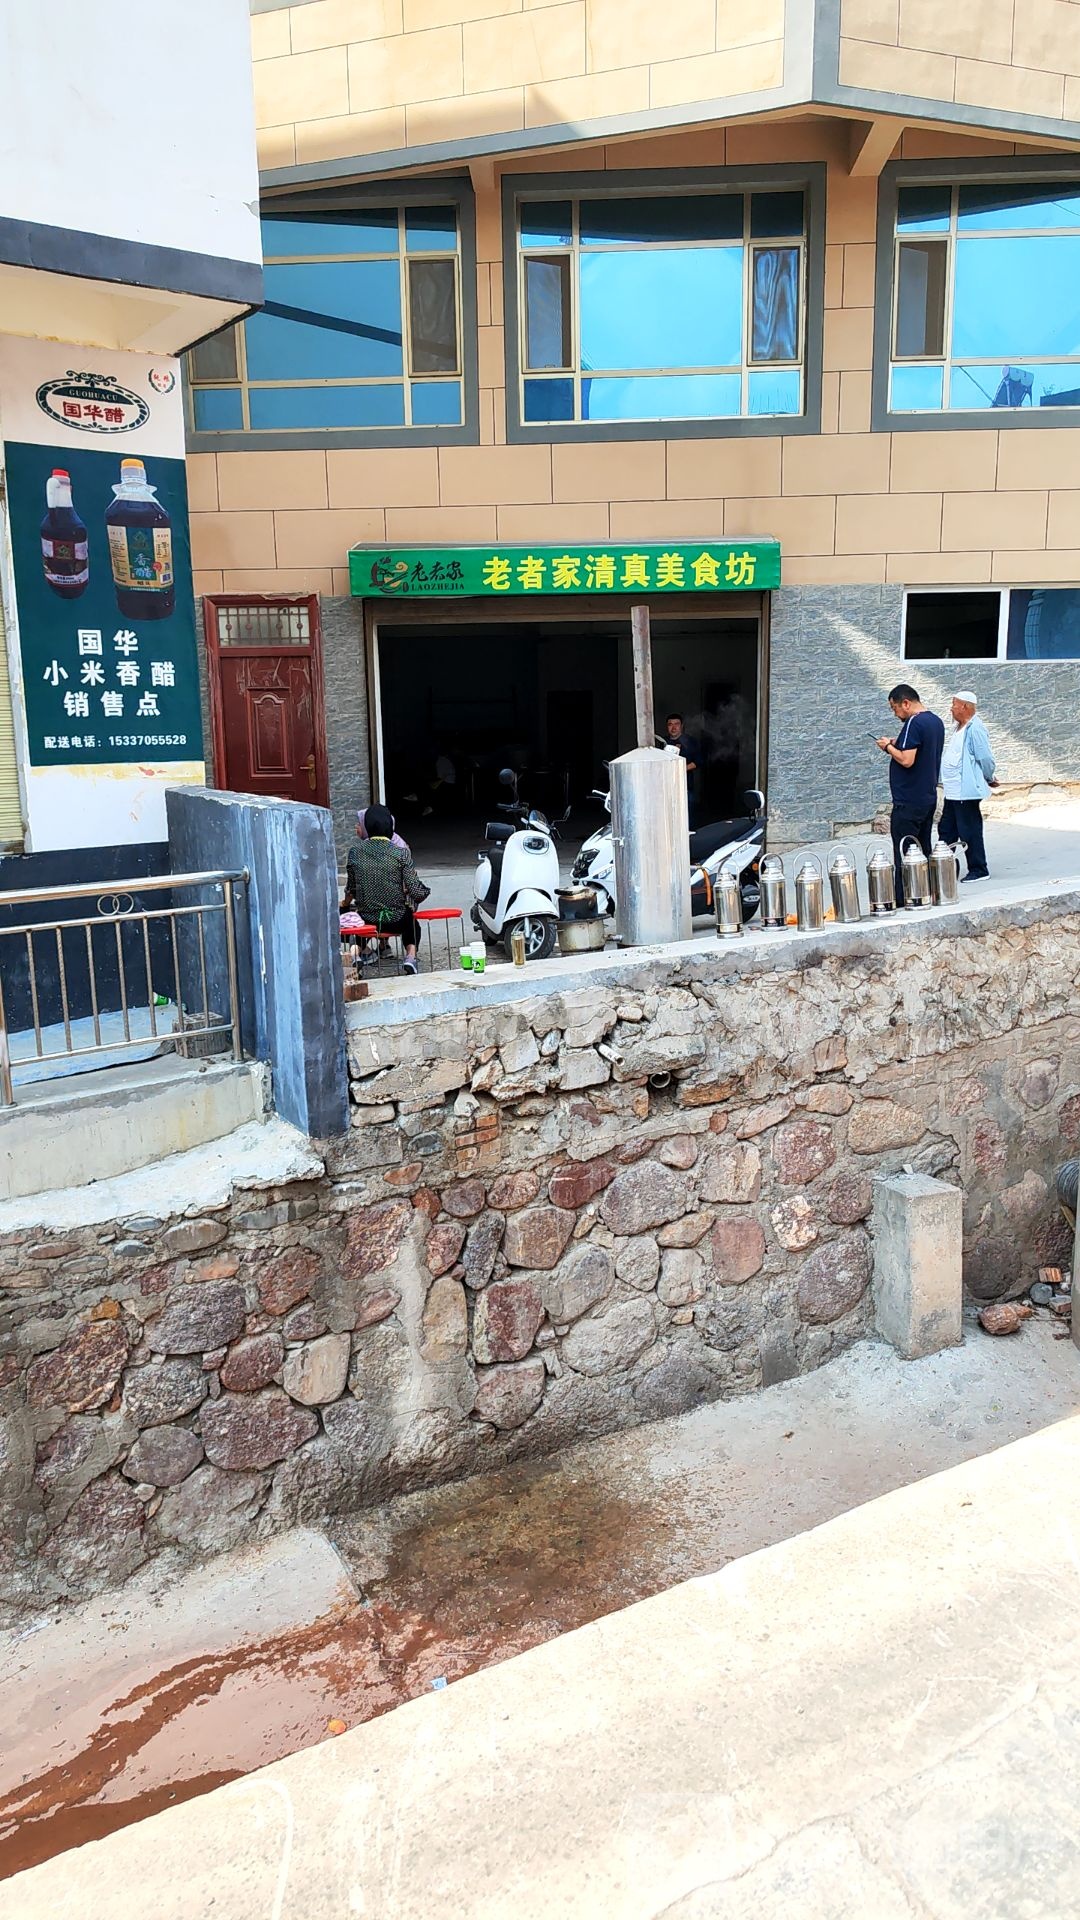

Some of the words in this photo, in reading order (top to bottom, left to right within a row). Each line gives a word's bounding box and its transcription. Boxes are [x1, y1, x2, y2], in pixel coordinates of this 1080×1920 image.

[68, 388, 118, 402] GUOHUACU
[62, 401, 125, 424] 国华醋
[482, 552, 757, 590] 老者家清真美食坊
[411, 583, 465, 591] LAOZHEJIA
[77, 629, 139, 656] 国华
[43, 660, 176, 687] 小米香醋
[63, 690, 161, 717] 销售点
